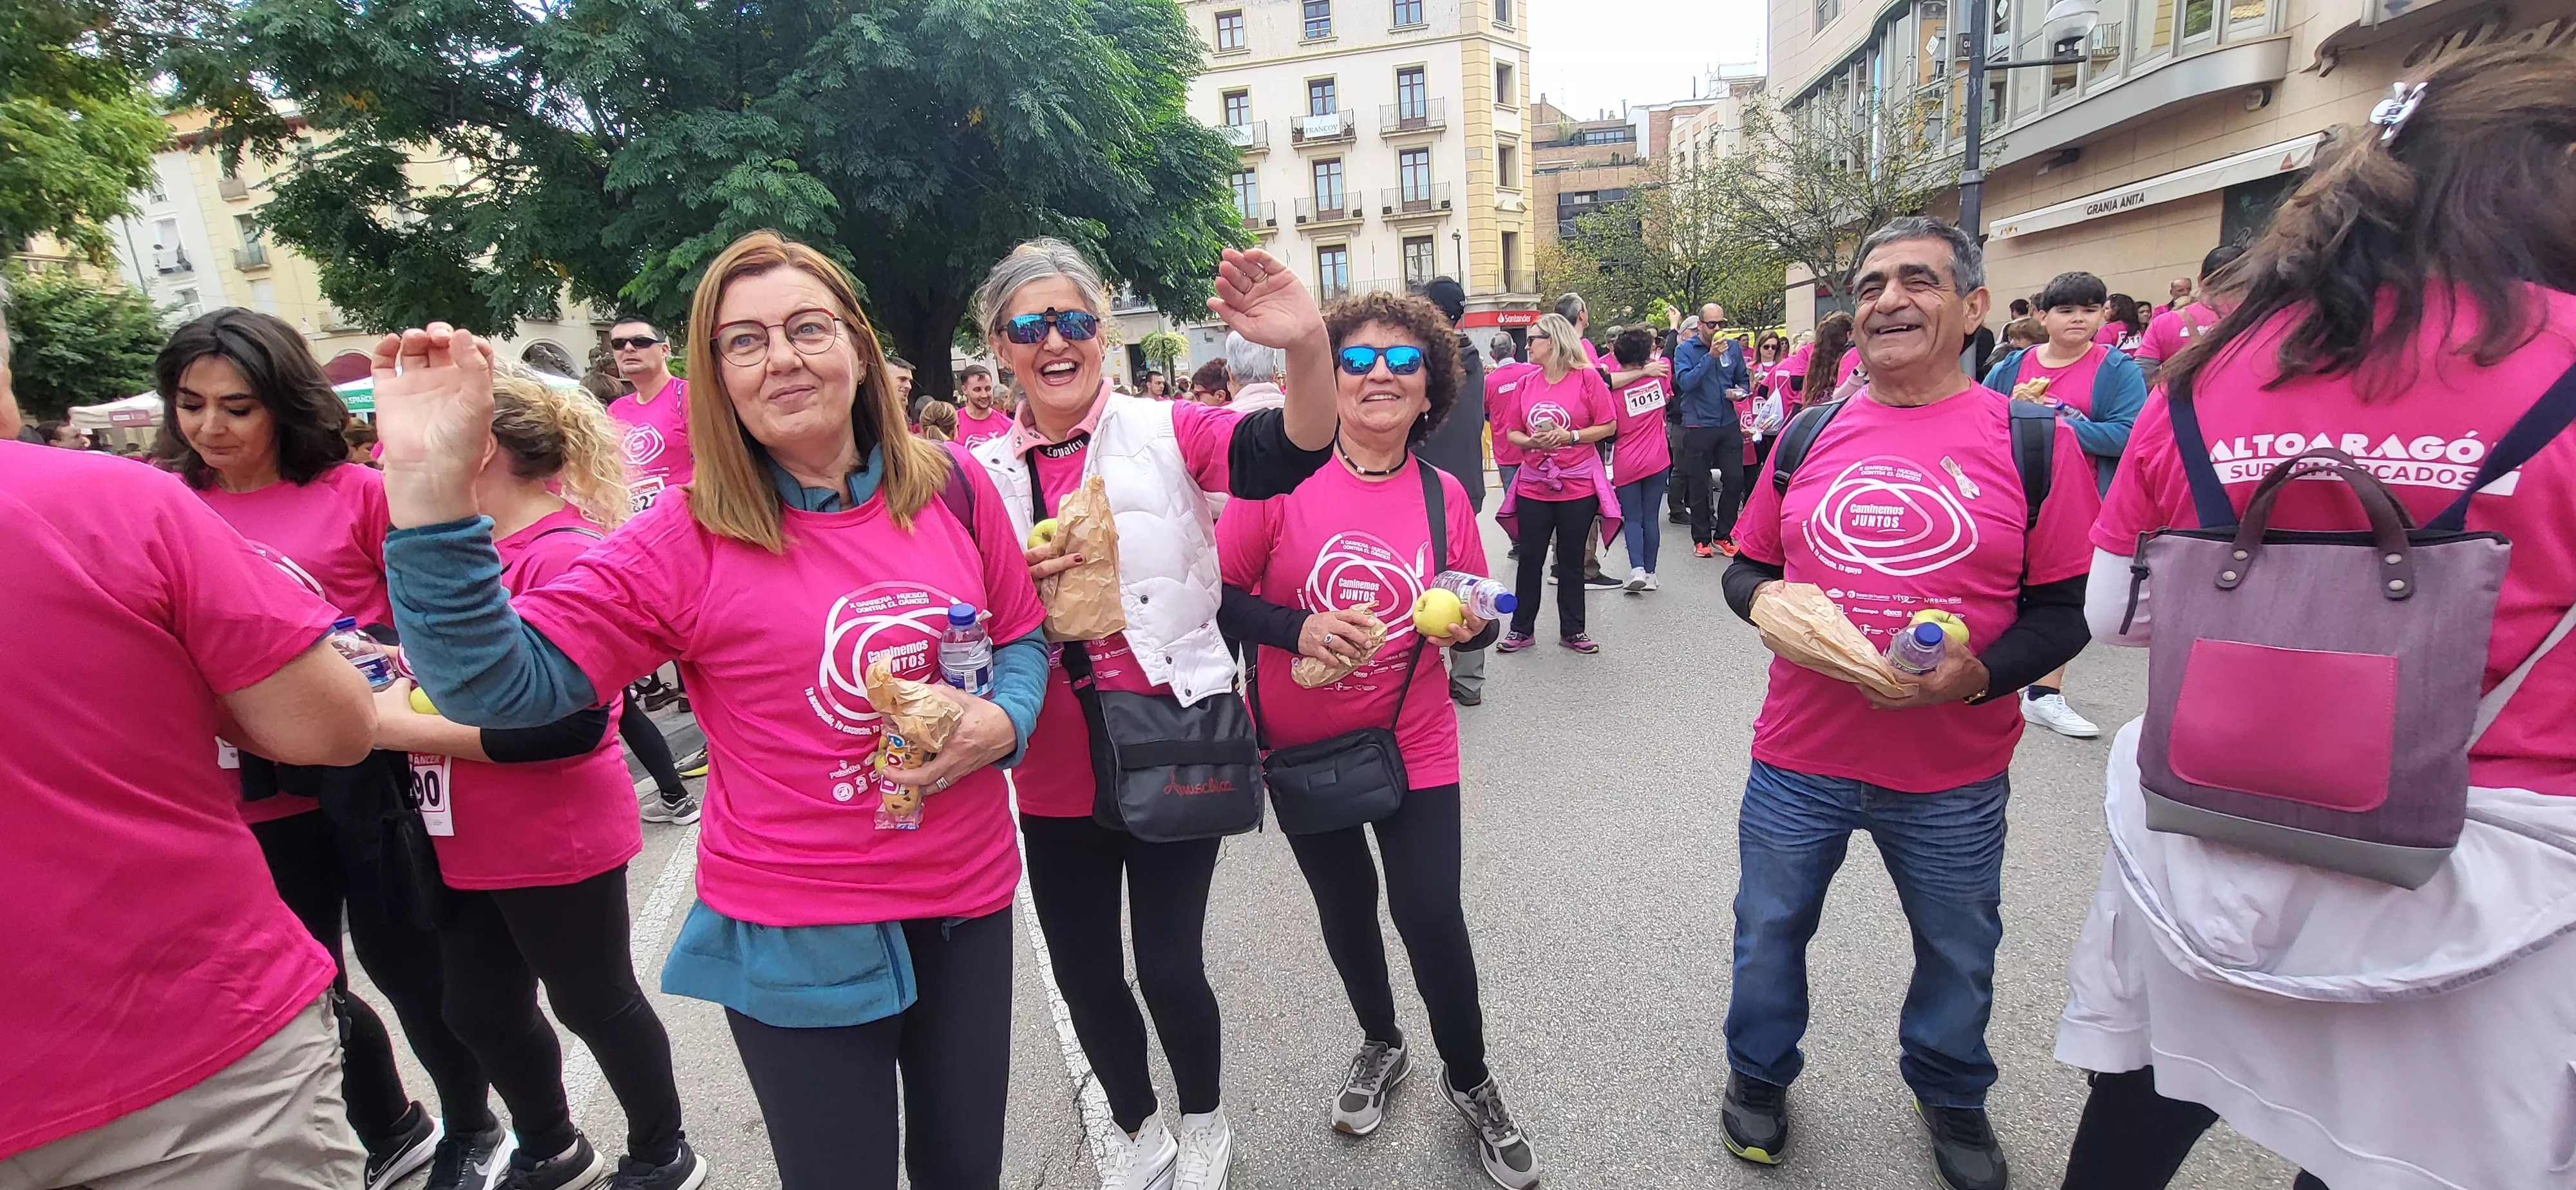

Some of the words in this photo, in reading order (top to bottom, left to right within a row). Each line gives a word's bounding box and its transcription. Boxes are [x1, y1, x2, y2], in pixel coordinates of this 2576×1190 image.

[2087, 199, 2117, 215] GRANJA
[2120, 193, 2145, 208] ANITA
[1504, 314, 1531, 323] Santander
[1631, 390, 1660, 408] 1013
[1046, 439, 1084, 458] Loyalty
[2210, 430, 2523, 468] ALTOARAGÓ
[1850, 504, 1905, 515] Caminemos
[1852, 515, 1900, 528] JUNTOS
[1338, 578, 1380, 591] Caminemos
[855, 595, 893, 607] CARRERA
[1340, 588, 1376, 603] JUNTOS
[856, 603, 887, 614] CONTRA
[891, 652, 925, 673] NTOS
